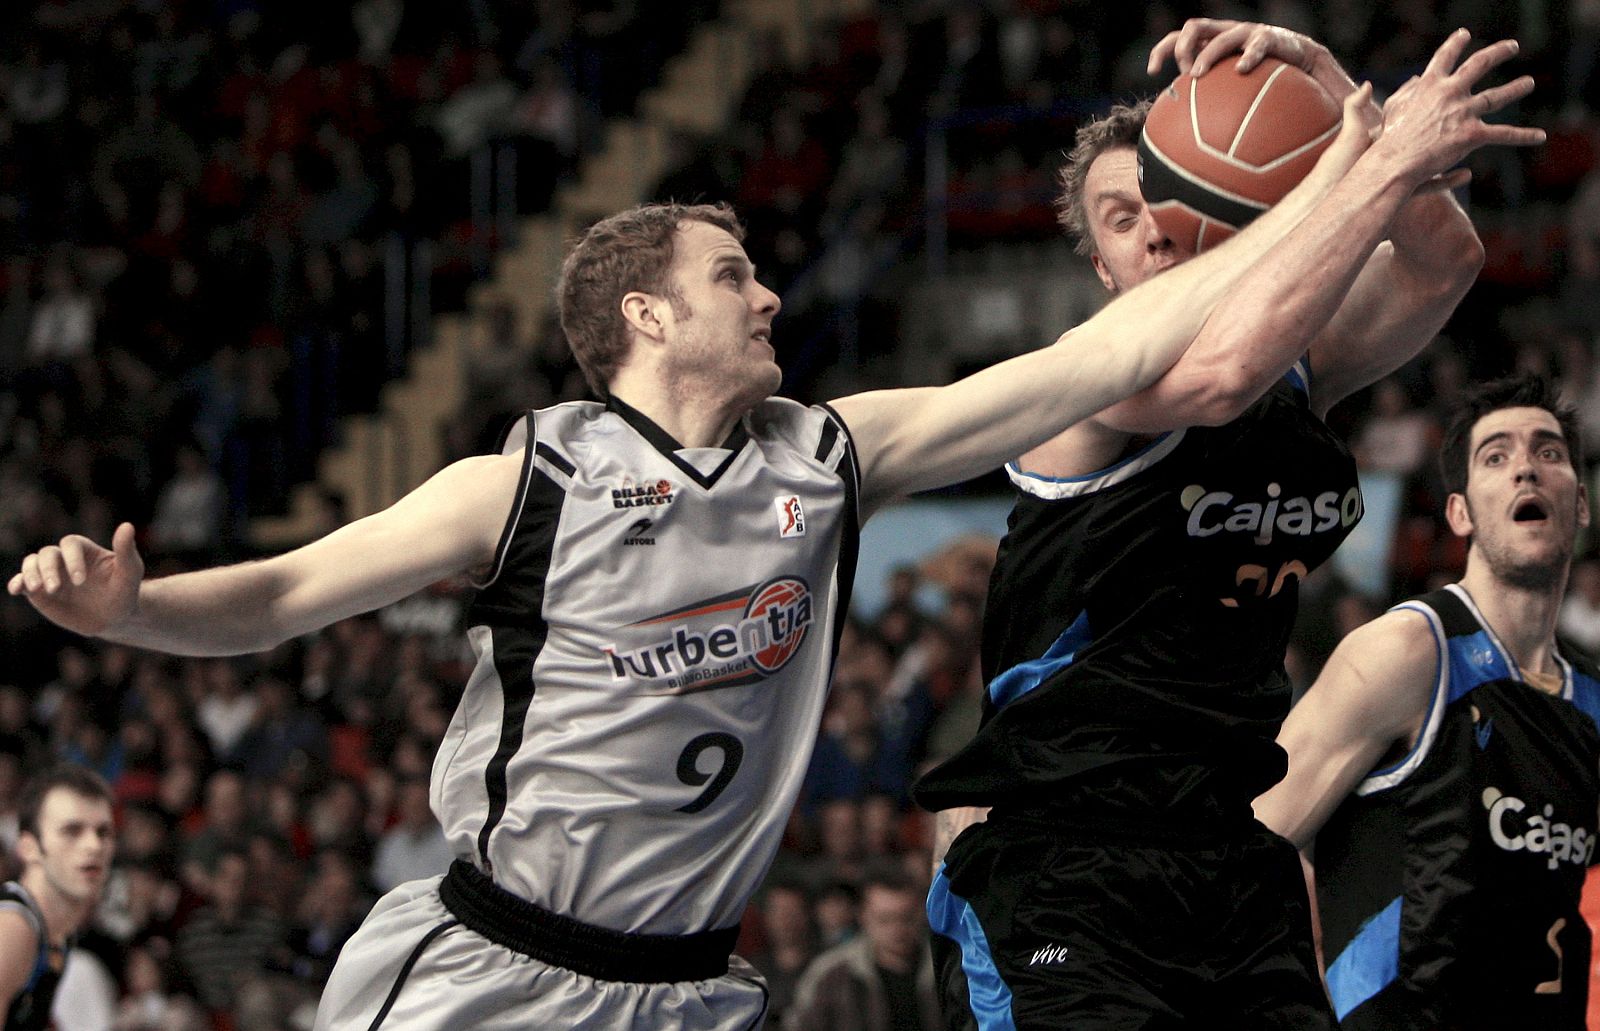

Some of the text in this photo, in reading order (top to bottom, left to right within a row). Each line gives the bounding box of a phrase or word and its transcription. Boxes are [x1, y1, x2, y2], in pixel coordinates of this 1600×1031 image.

[613, 494, 673, 509] BASKET
[794, 503, 803, 532] ACB
[673, 731, 744, 814] 9
